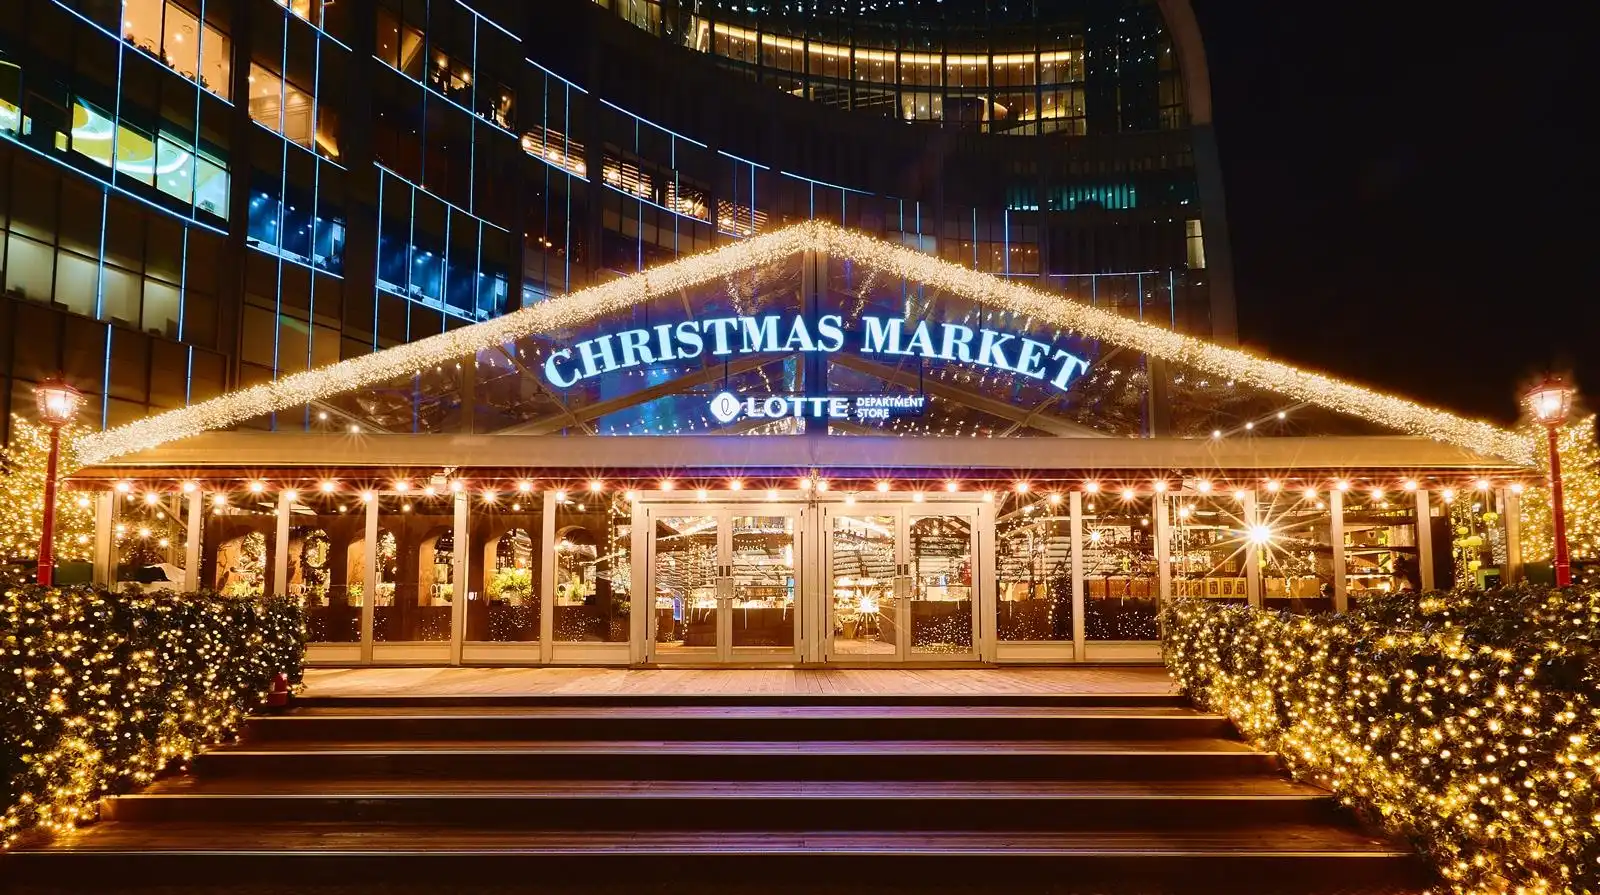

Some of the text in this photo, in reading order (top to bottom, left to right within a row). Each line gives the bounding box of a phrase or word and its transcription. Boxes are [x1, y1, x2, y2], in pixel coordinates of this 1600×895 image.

[545, 315, 1090, 391] CHRISTMAS MARKET
[747, 397, 849, 417] LOTTE
[856, 397, 924, 407] DEPARTMENT
[857, 409, 889, 418] STORE
